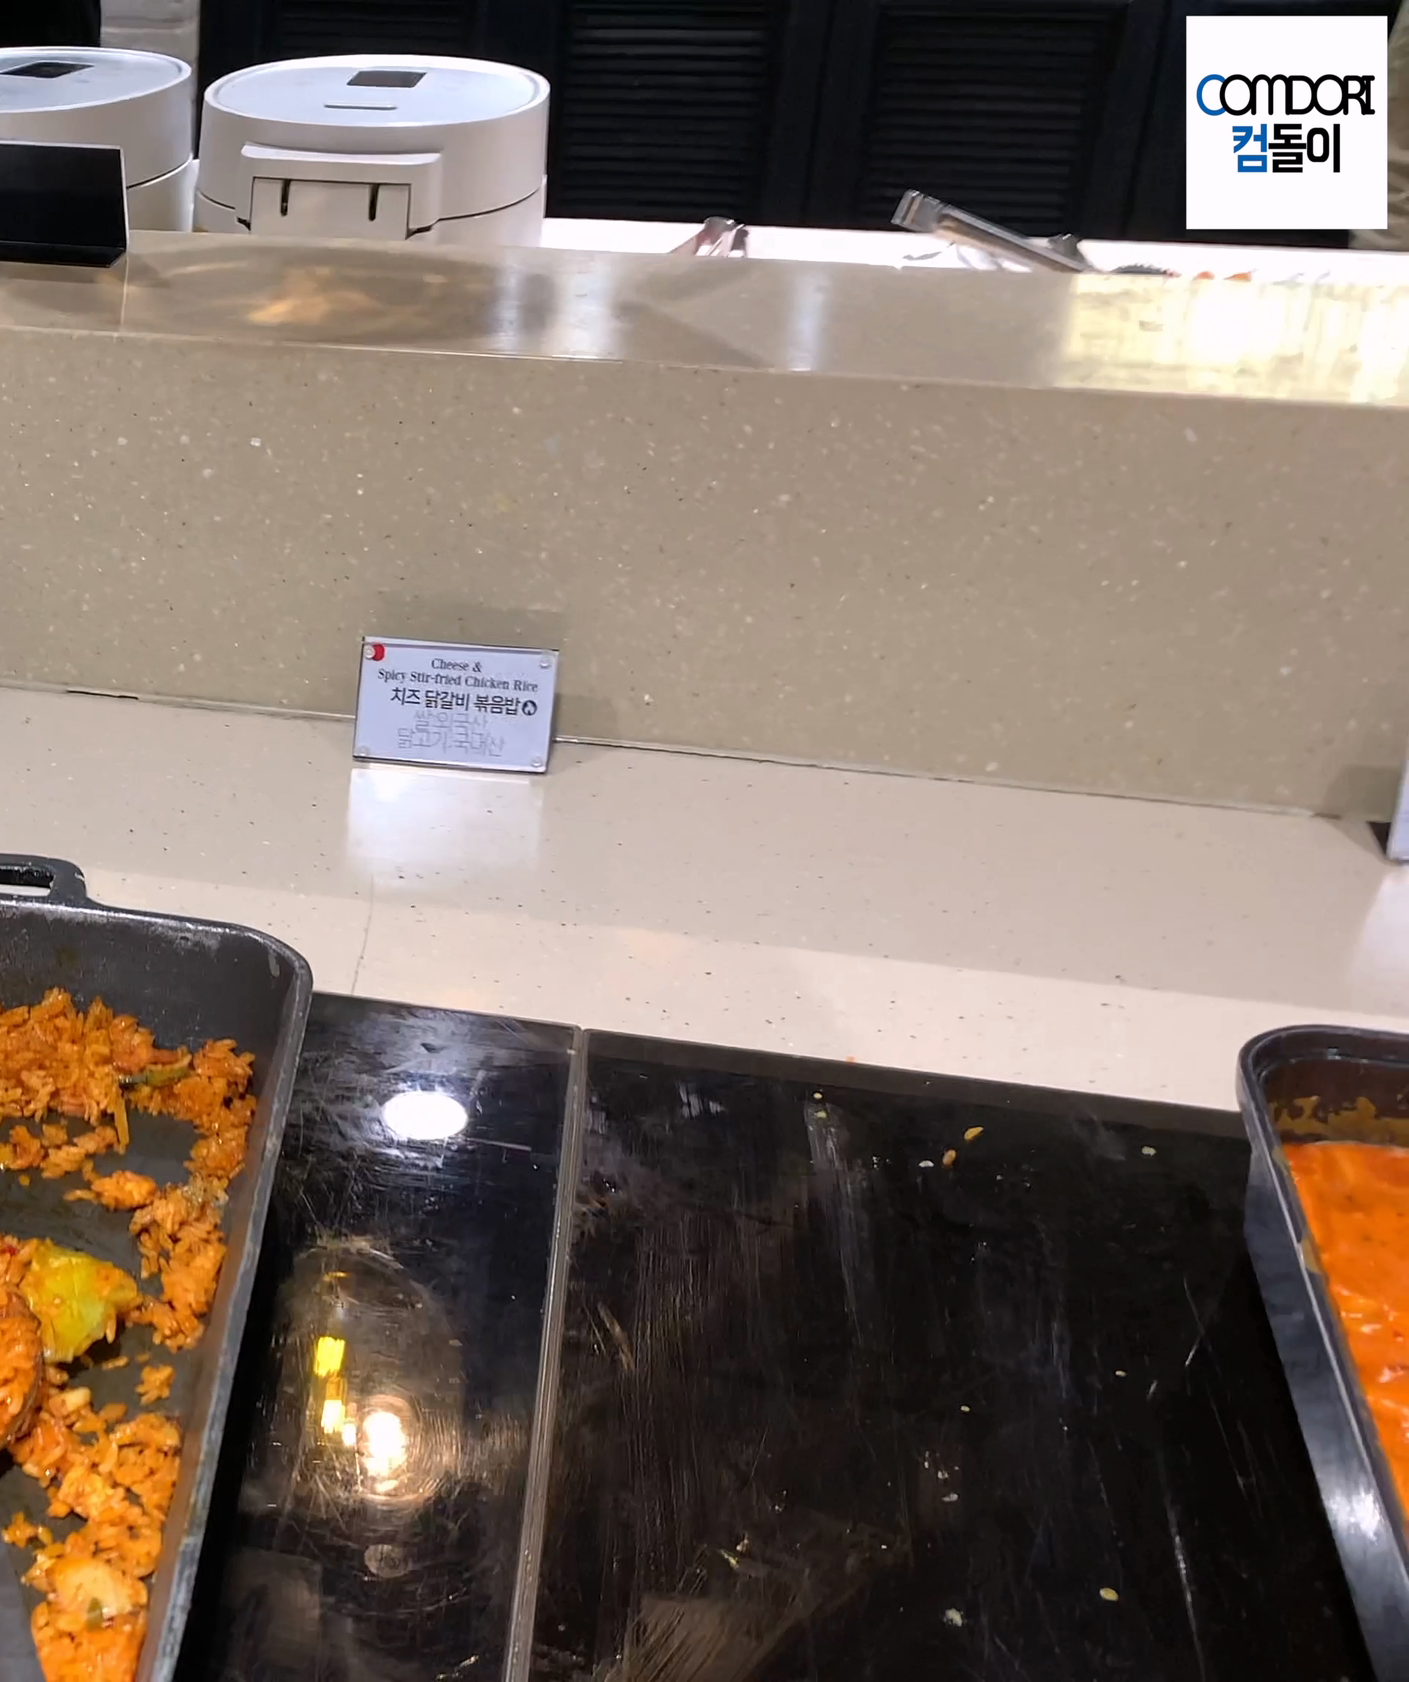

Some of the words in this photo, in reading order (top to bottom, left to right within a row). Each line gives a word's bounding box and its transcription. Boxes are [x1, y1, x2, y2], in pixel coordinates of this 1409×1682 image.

[431, 658, 469, 671] Cheese
[472, 662, 482, 673] &
[378, 668, 406, 684] Spicy
[410, 671, 461, 686] Stir-fried
[465, 676, 509, 690] Chicken
[513, 680, 538, 693] Rice
[390, 687, 420, 705] 치즈
[425, 689, 470, 711] 닭갈비
[473, 694, 522, 716] 볶음밥
